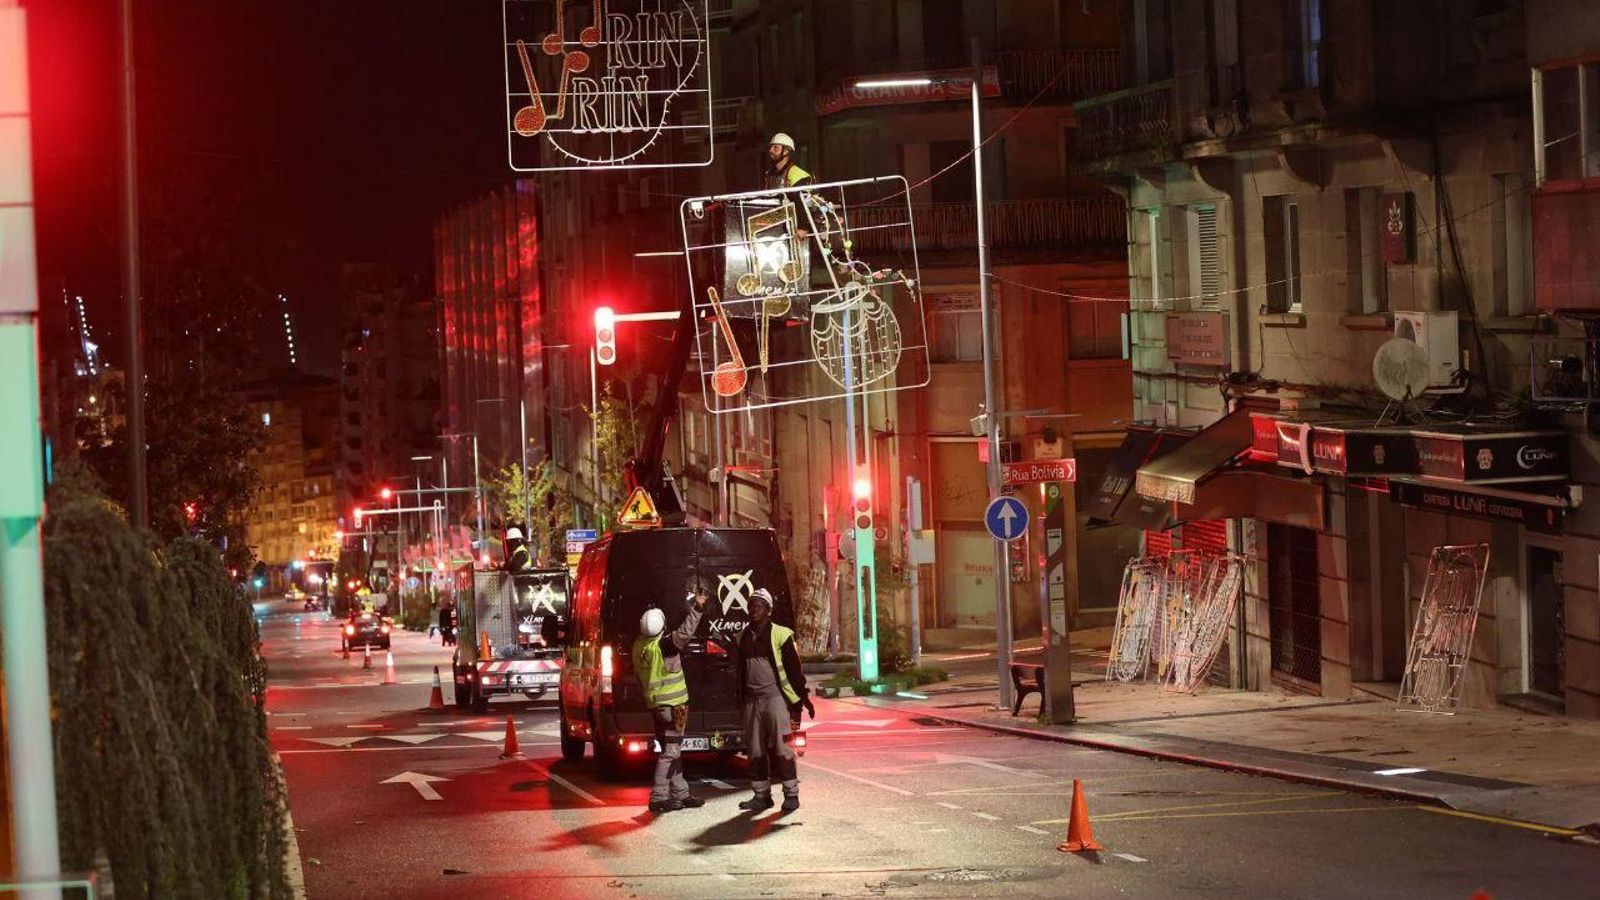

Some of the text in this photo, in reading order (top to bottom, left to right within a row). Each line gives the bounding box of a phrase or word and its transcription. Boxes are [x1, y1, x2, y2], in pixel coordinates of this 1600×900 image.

[606, 12, 683, 69] RIN
[571, 76, 650, 134] RIN
[1012, 464, 1065, 481] Rúa Bolivia
